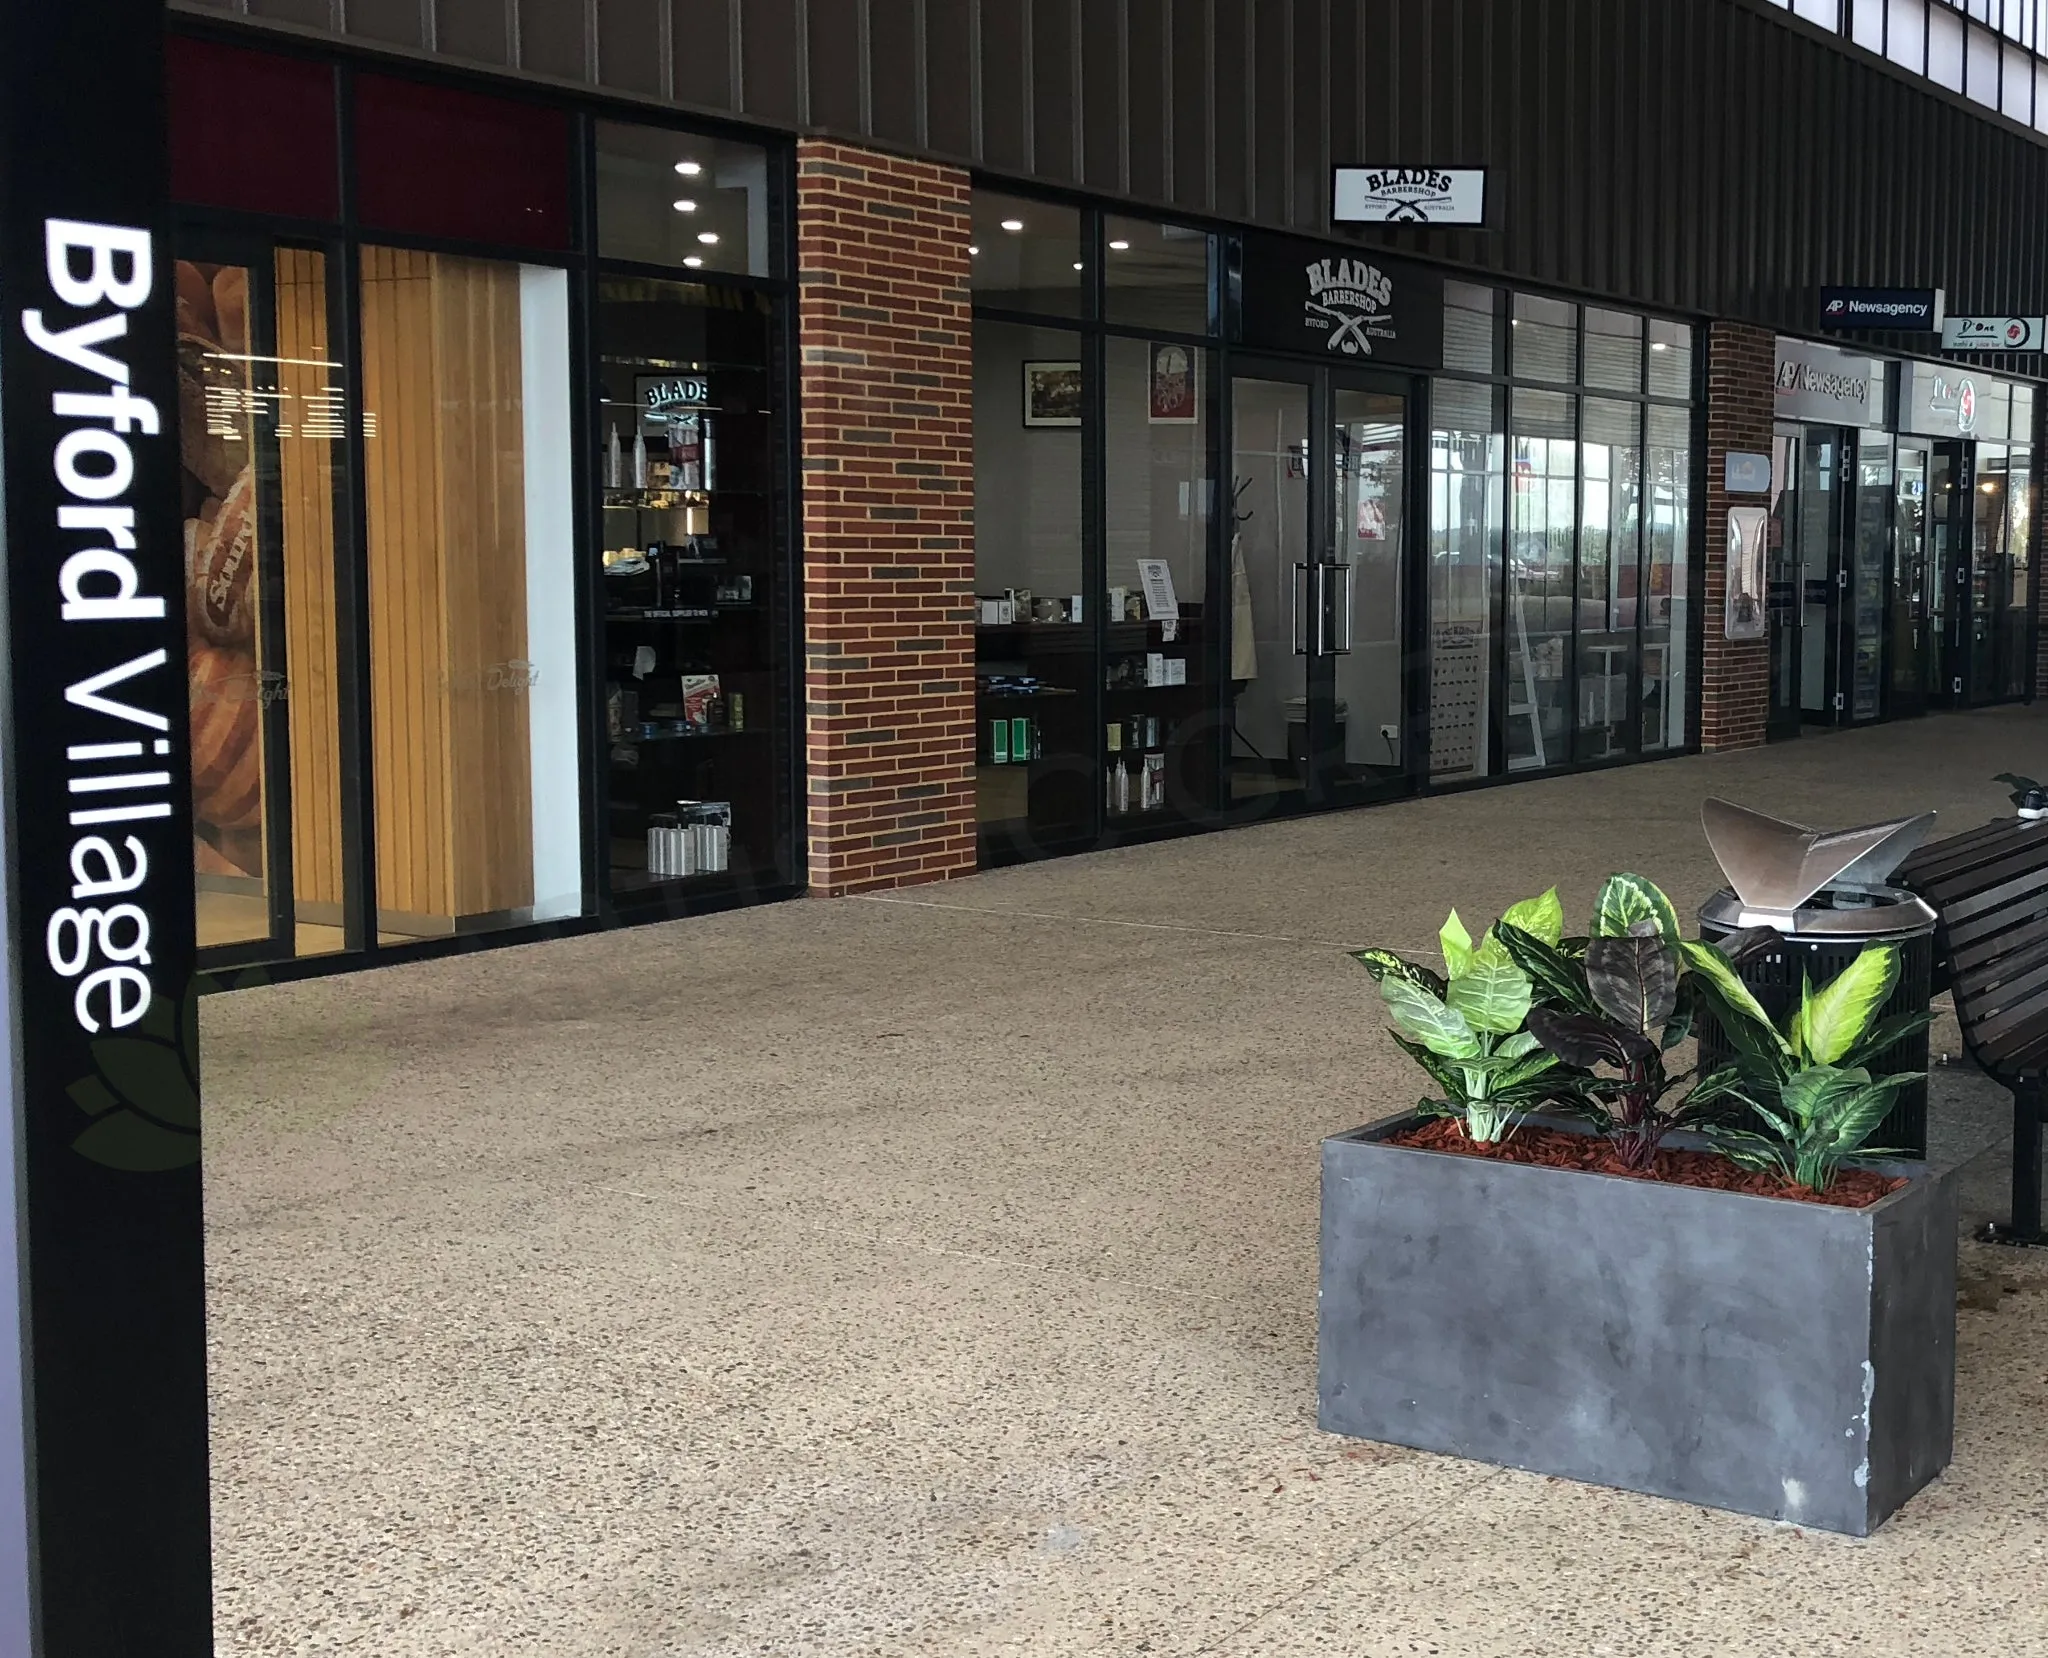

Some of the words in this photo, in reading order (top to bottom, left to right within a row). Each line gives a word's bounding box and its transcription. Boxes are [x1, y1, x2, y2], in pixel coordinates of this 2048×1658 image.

[1366, 169, 1453, 193] BLADES
[1381, 186, 1436, 198] BARBERSHOP
[1305, 258, 1393, 307] BLADES
[1322, 288, 1377, 314] BARBERSHOP
[1826, 299, 1844, 313] AP
[1848, 300, 1928, 317] Newsagency
[1779, 361, 1797, 387] AP
[1803, 365, 1868, 405] Newsagency
[21, 218, 166, 620] Byford
[47, 648, 172, 1034] Village
